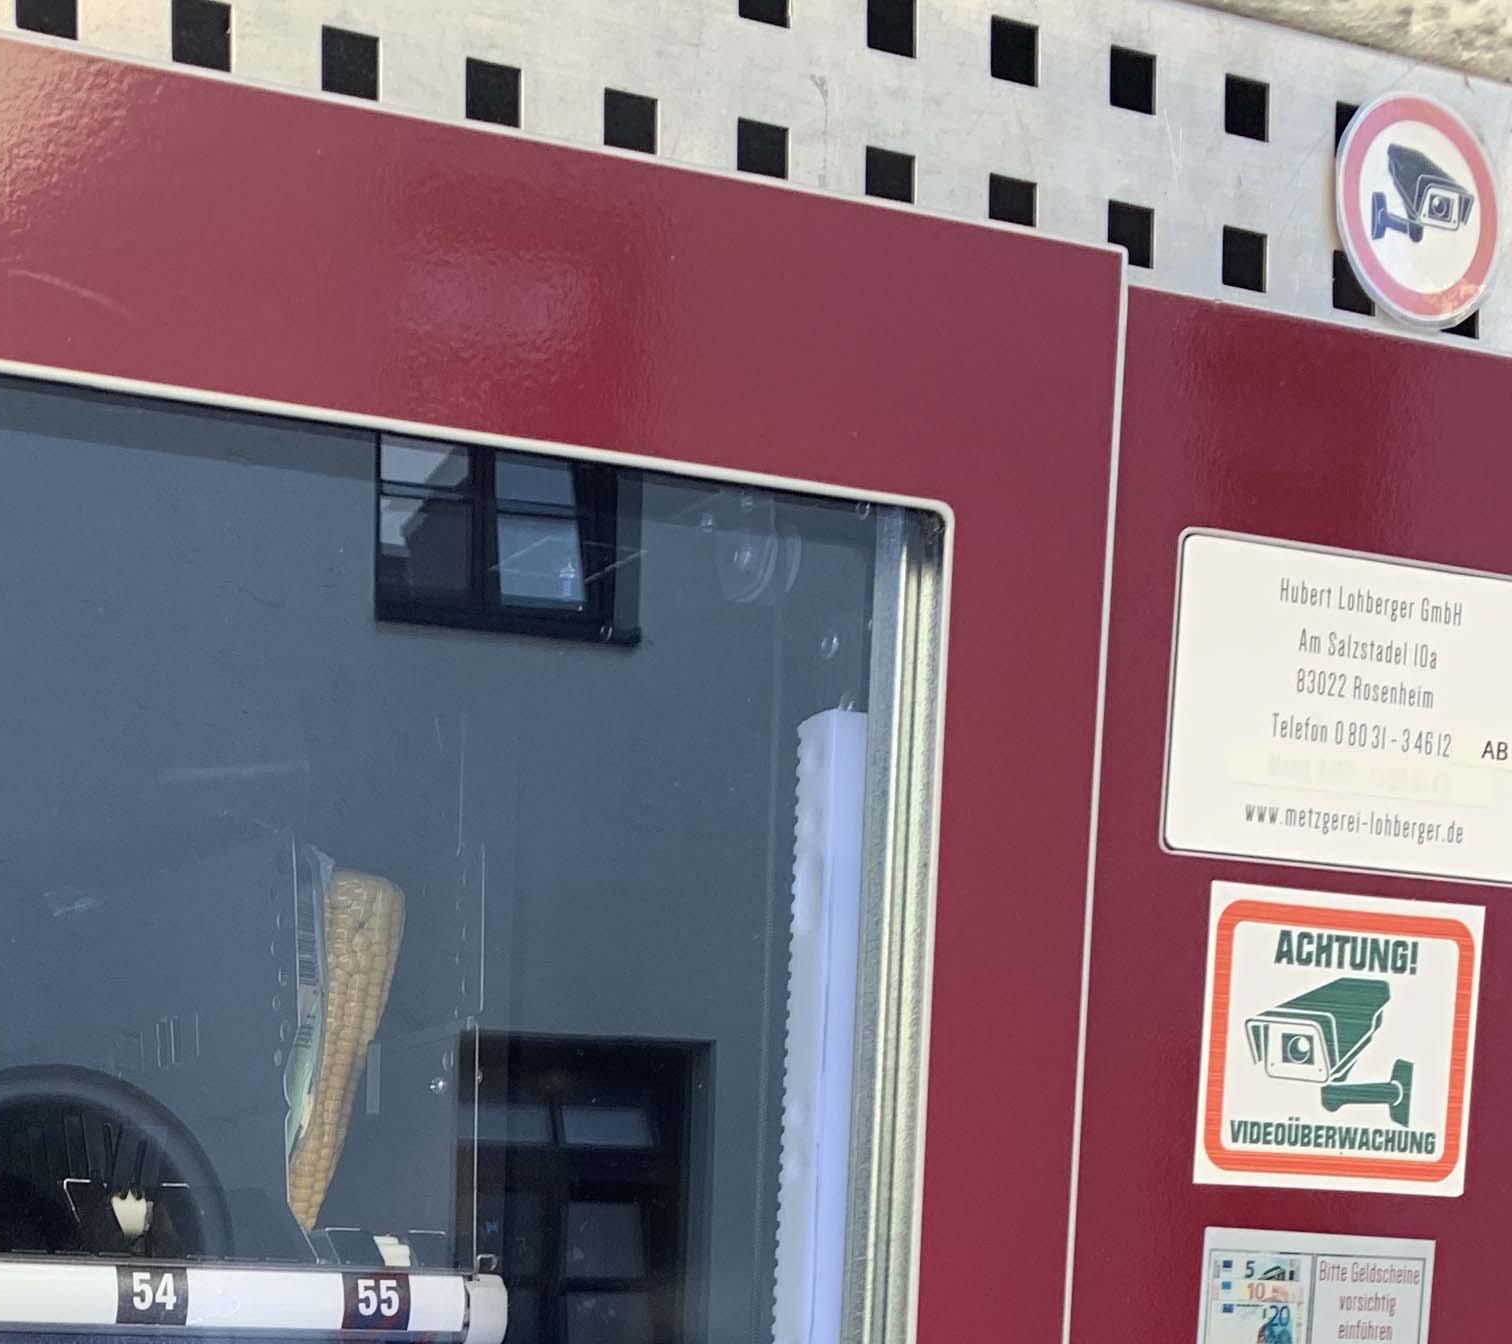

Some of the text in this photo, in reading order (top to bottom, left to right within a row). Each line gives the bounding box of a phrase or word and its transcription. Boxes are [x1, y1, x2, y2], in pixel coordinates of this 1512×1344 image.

[1280, 577, 1463, 626] Hubert Lohberger GmbH
[1298, 628, 1438, 670] Am Salzstadel 10a
[1296, 667, 1435, 709] 83022 Rosenheim
[1272, 712, 1329, 744] Telefon
[1244, 803, 1465, 846] www.metzgerei-lohberger.de
[1273, 929, 1420, 976] ACHTUNG!
[1229, 1115, 1438, 1156] VIDEOÜBERWACHUNG
[1244, 1260, 1256, 1279] 5
[1319, 1260, 1422, 1286] Bitte Geldscheine
[132, 1272, 177, 1310] 54
[358, 1279, 399, 1316] 55
[1247, 1282, 1266, 1301] 10
[1338, 1293, 1398, 1317] vorsichtig
[1268, 1305, 1290, 1328] 20
[1337, 1320, 1394, 1342] einführen
